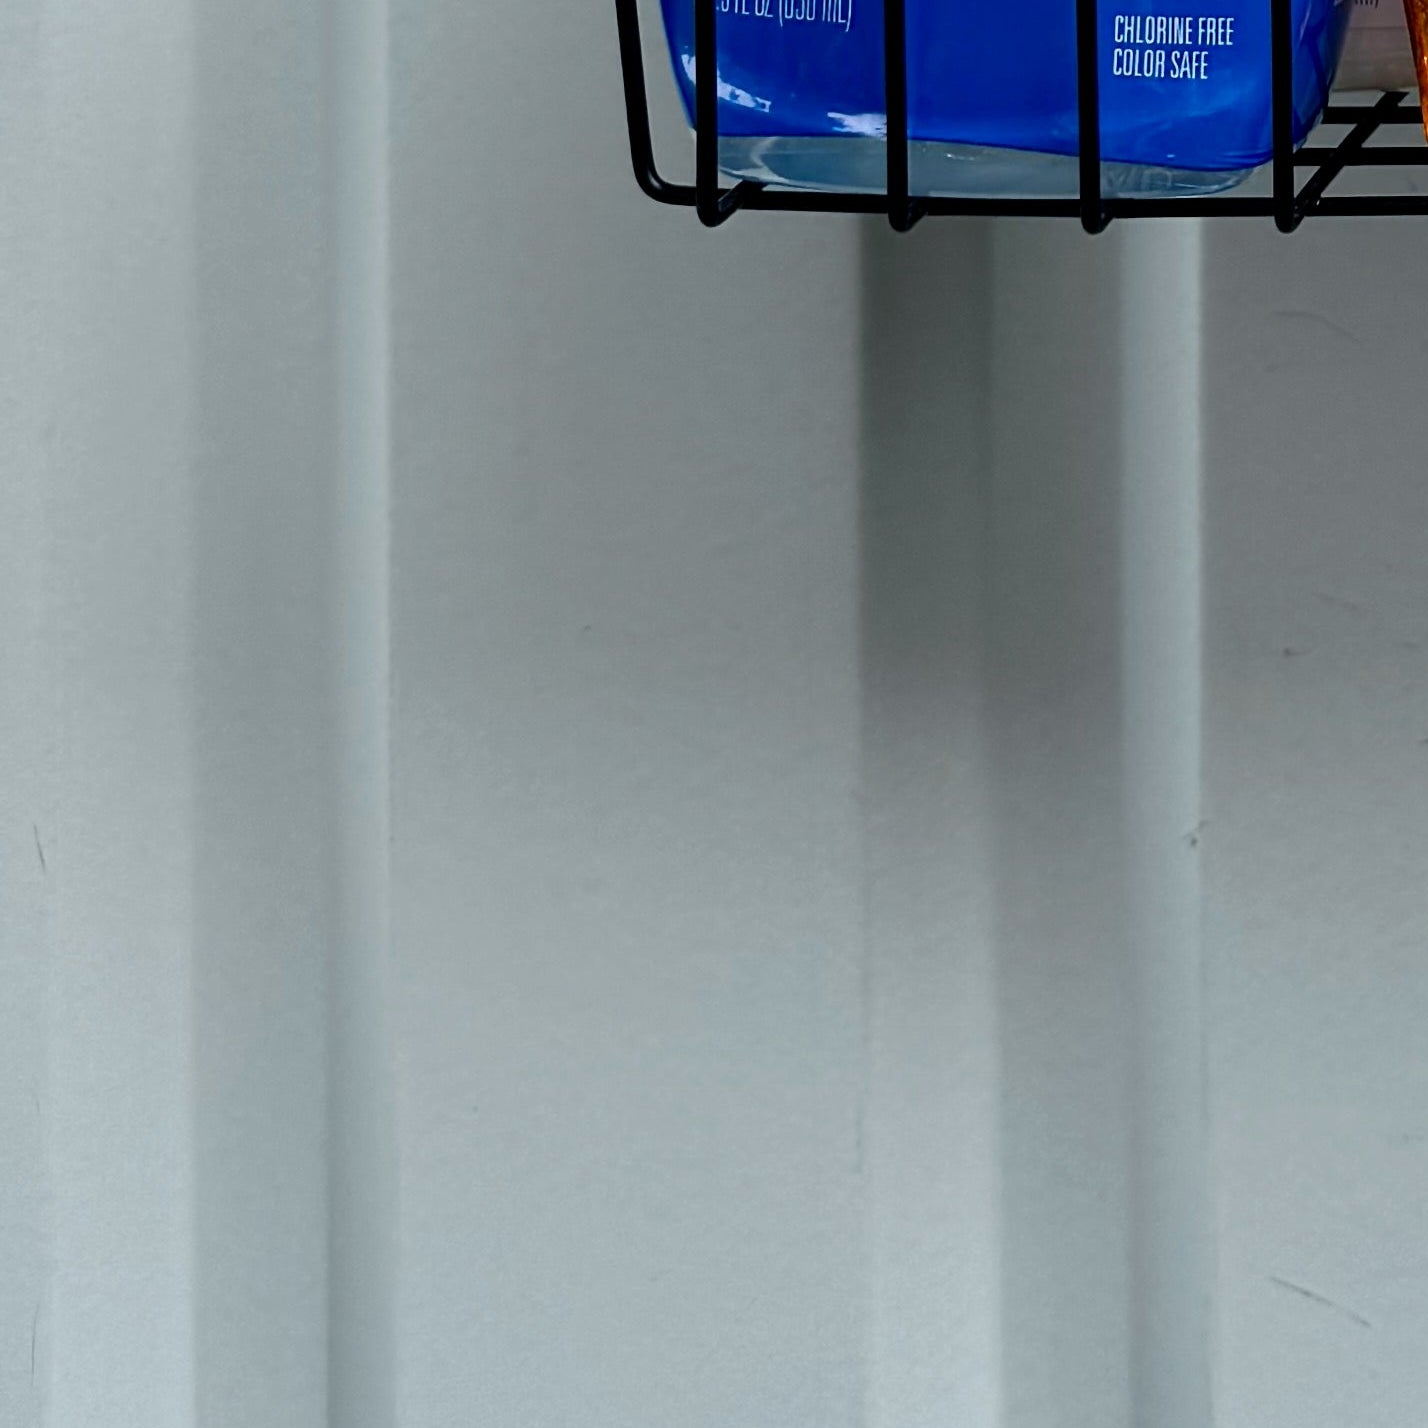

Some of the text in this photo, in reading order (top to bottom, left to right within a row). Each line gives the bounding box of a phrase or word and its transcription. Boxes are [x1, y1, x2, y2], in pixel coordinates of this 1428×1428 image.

[1114, 15, 1235, 46] CHLORINE FREE
[1113, 48, 1209, 79] COLOR SAFE
